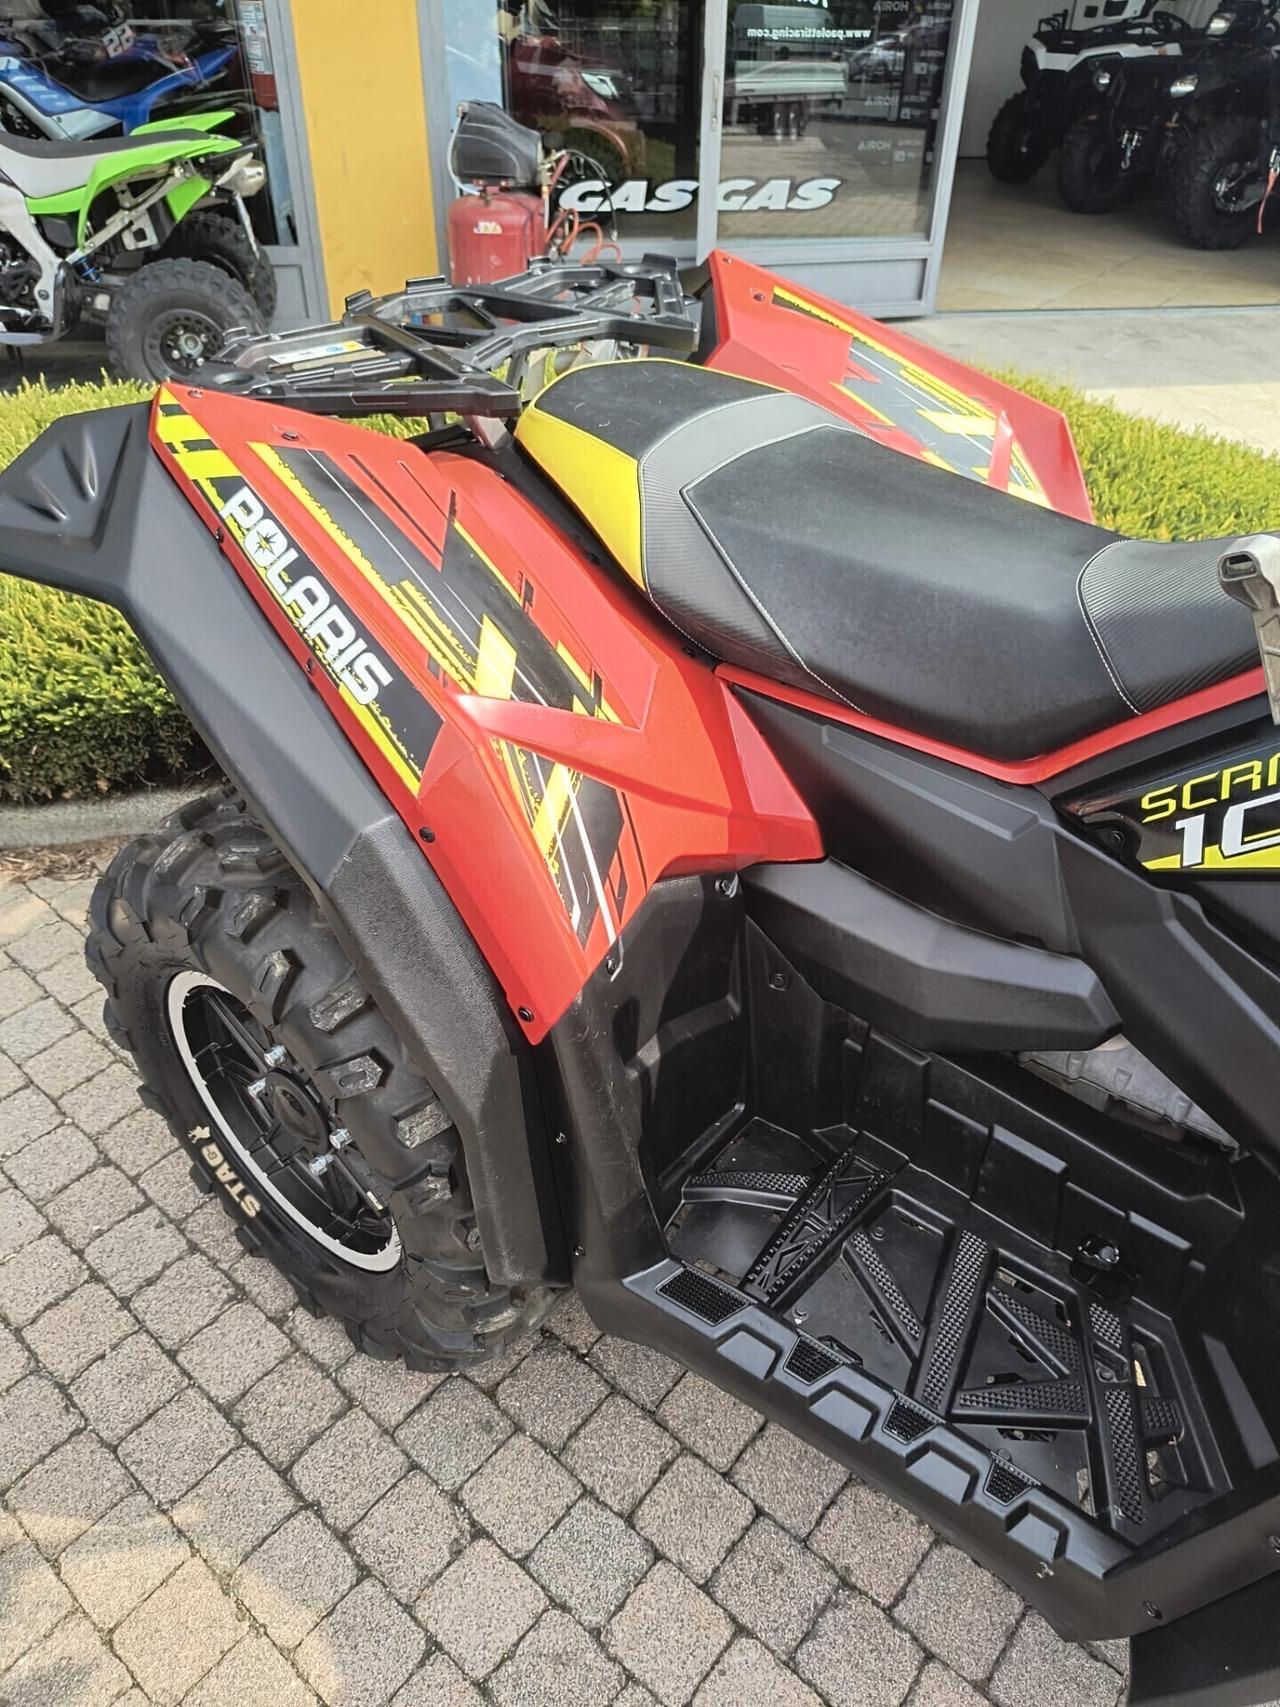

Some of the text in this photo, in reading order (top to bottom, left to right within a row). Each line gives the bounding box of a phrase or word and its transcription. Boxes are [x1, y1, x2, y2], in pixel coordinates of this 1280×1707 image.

[872, 1, 909, 12] AIROH
[558, 179, 842, 212] GAS GAS
[219, 486, 393, 705] POLARIS
[201, 1142, 261, 1218] STAG
